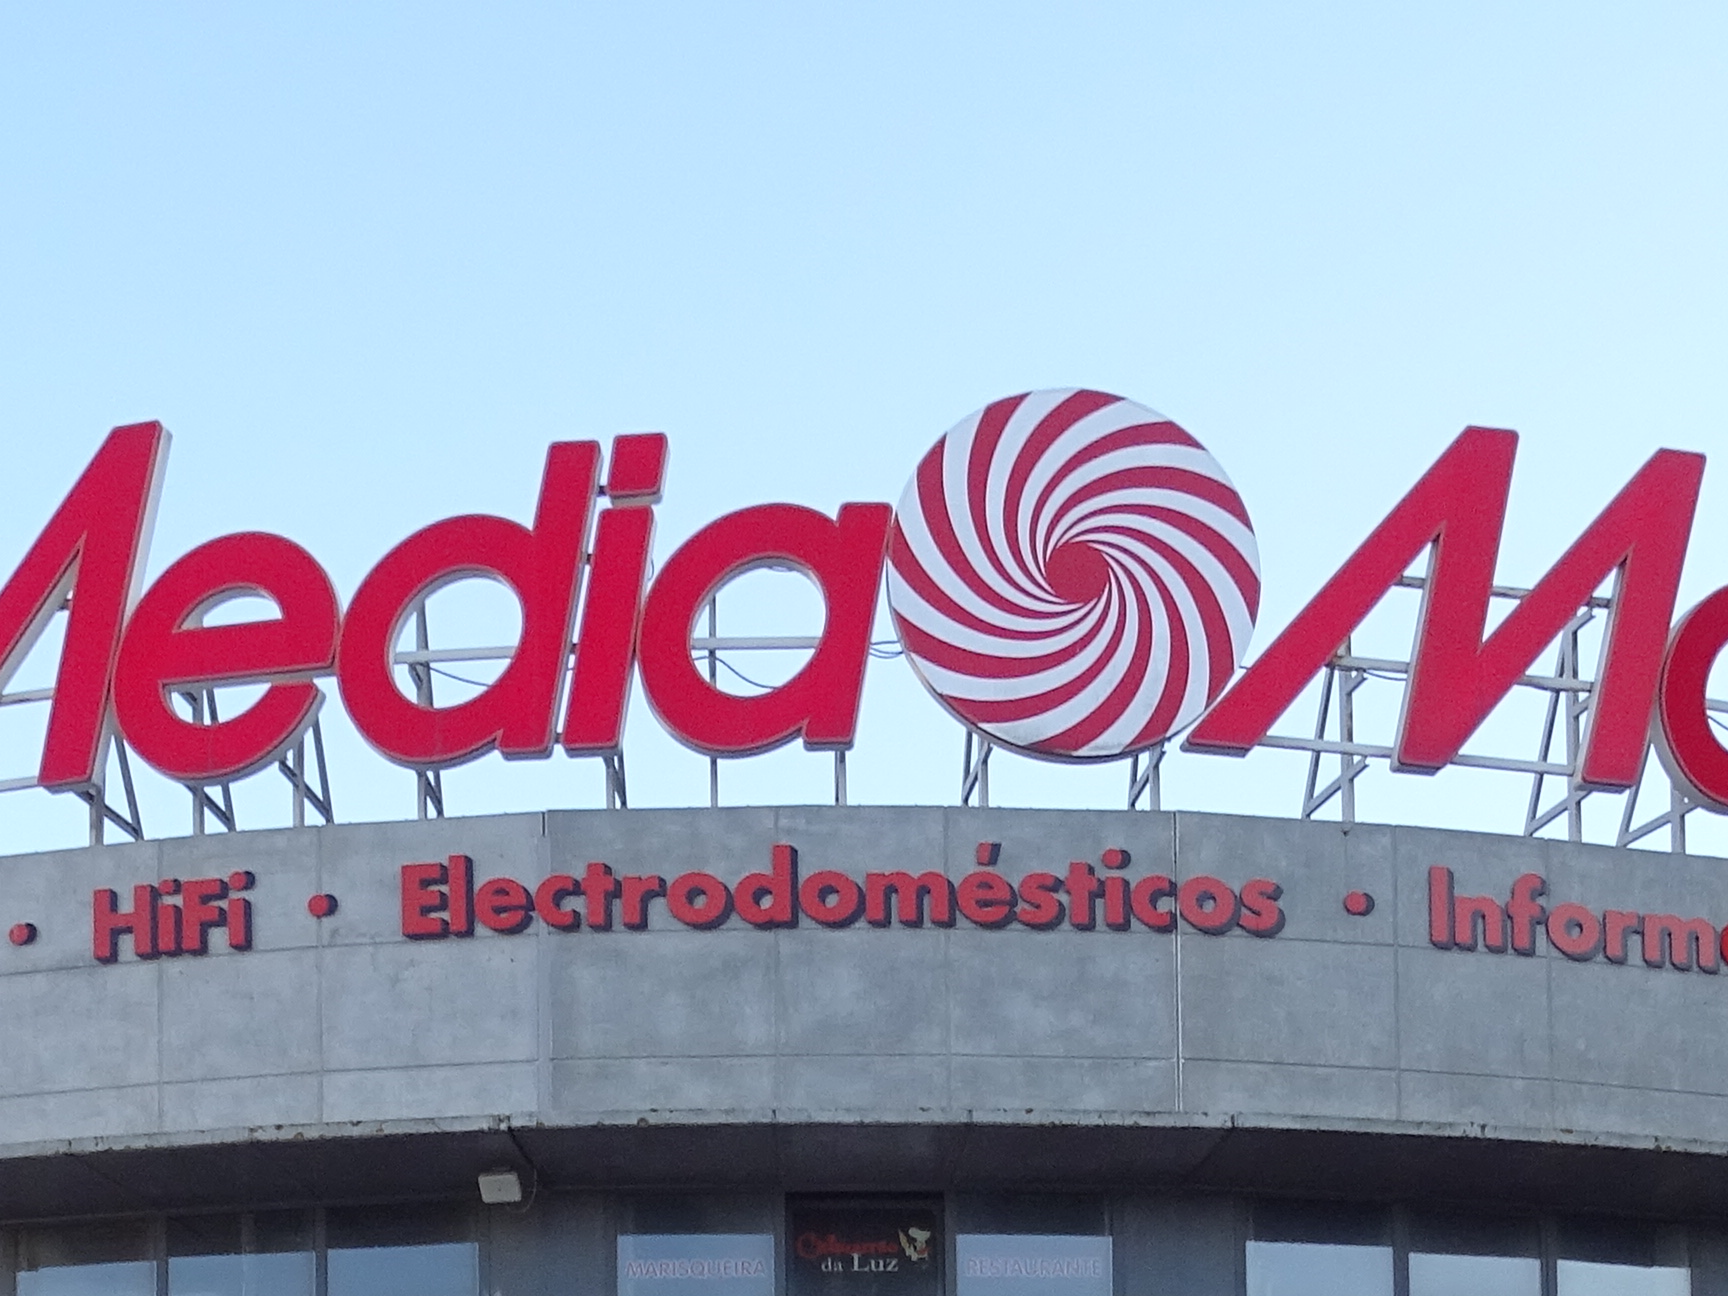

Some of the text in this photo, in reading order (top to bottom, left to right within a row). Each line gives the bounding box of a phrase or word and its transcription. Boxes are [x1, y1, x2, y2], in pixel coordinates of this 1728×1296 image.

[92, 870, 255, 965] HiFi
[400, 843, 1284, 941] Electrodomésticos
[625, 1258, 765, 1279] MARISQUEIRA
[821, 1252, 899, 1274] da Luz
